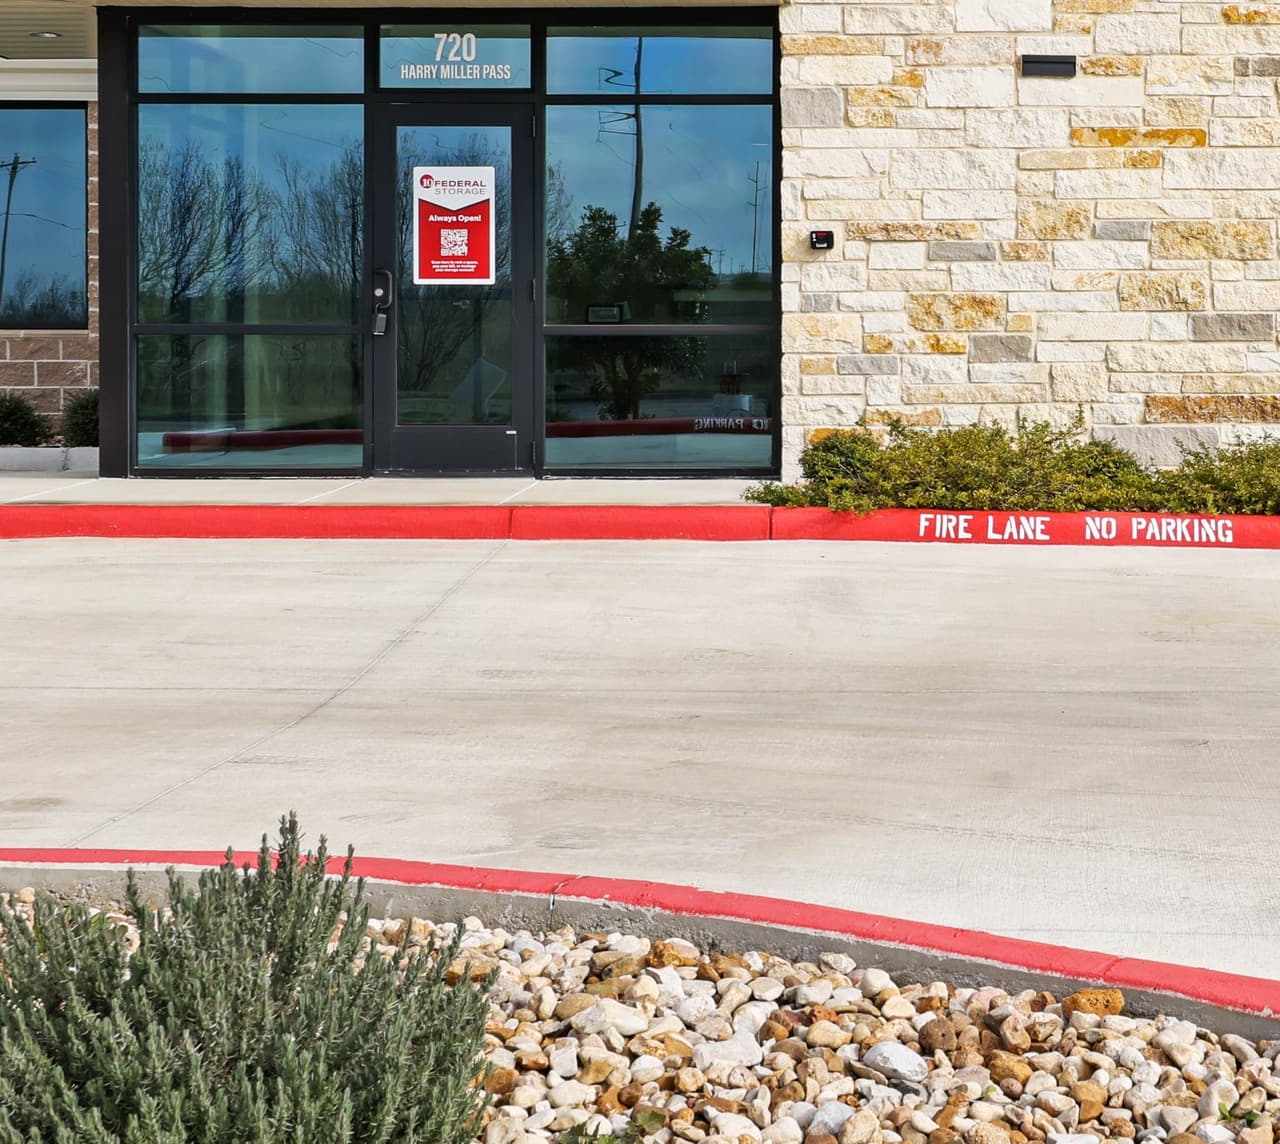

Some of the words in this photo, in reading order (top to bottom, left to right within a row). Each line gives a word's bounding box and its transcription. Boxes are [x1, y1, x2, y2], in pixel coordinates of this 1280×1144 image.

[434, 33, 477, 62] 720
[401, 64, 438, 79] HARRY
[440, 64, 481, 79] MILLER
[483, 64, 511, 79] PASS
[429, 214, 457, 223] Always
[458, 214, 482, 223] Open!
[919, 513, 973, 539] FIRE
[987, 515, 1050, 541] LANE
[1085, 516, 1116, 539] NO
[1131, 517, 1233, 543] PARKING
